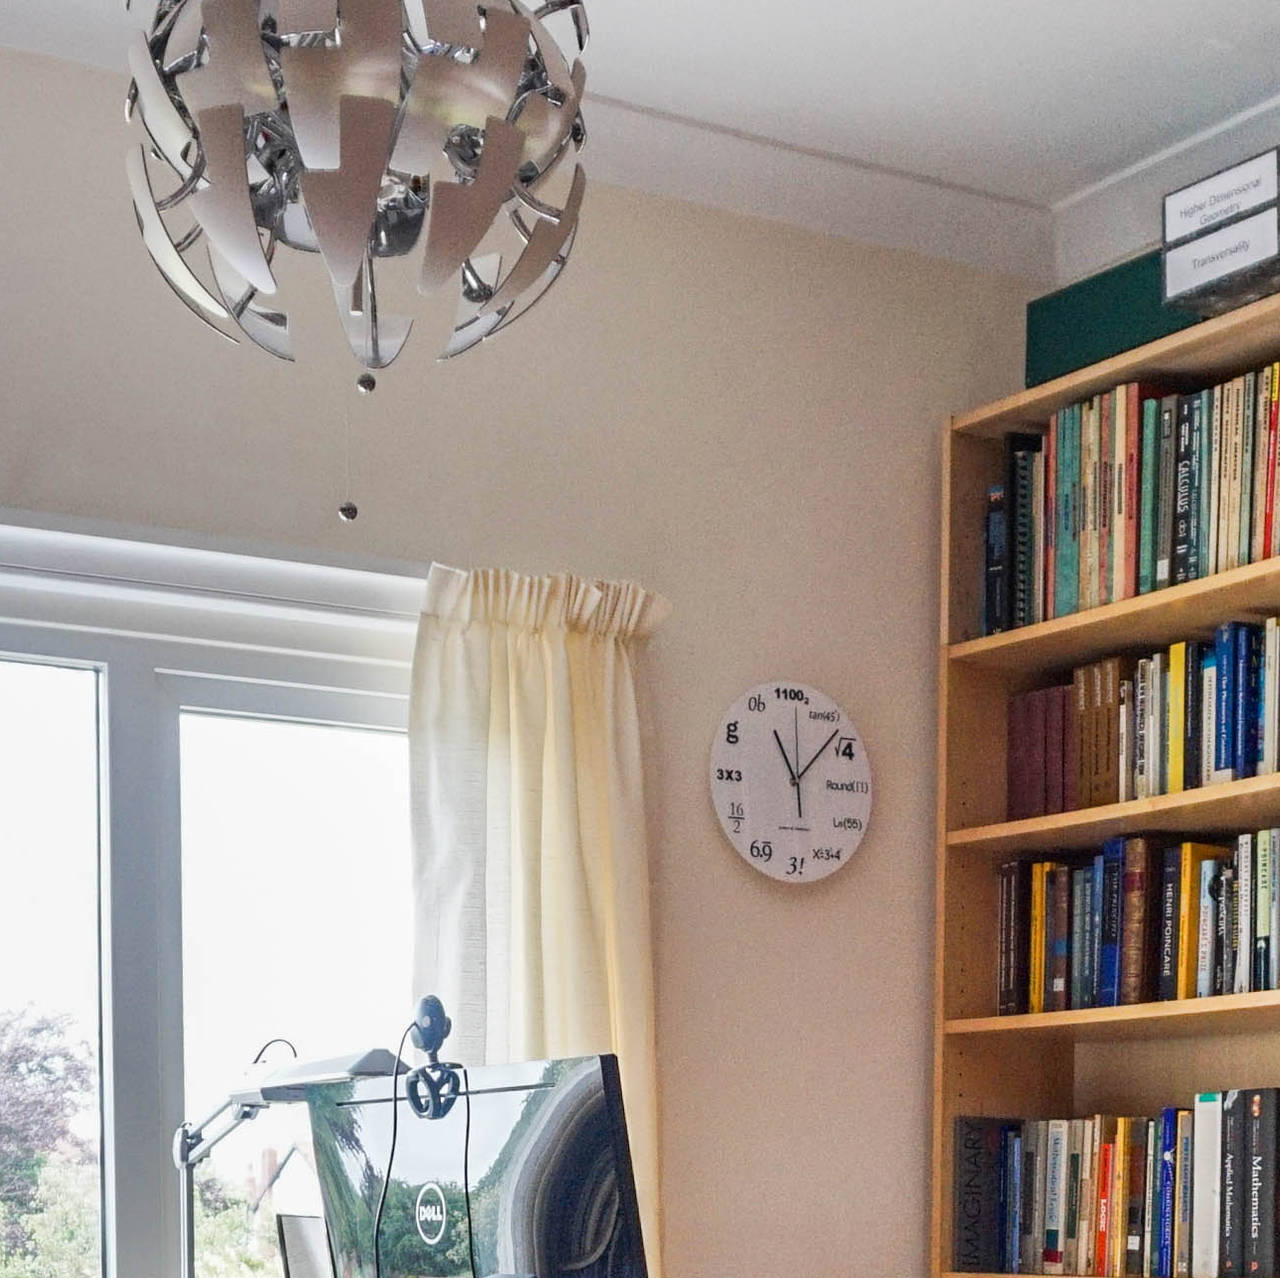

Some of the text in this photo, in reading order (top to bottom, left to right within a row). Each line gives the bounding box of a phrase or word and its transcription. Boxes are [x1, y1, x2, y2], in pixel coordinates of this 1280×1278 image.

[1179, 176, 1262, 219] Higher Dimensional
[1199, 201, 1241, 225] Geometry
[1191, 239, 1251, 270] Transversality
[1178, 460, 1190, 514] CALCULUS
[1220, 676, 1229, 690] The
[1220, 692, 1229, 724] Pleasures
[729, 802, 744, 816] 16
[733, 822, 741, 834] 2
[786, 856, 805, 876] 3!
[1163, 883, 1175, 918] HENRI
[1049, 1136, 1062, 1196] Mathematical
[962, 1120, 983, 1266] IMAGINARY
[1224, 1152, 1234, 1238] Applied Mathematics
[1251, 1155, 1263, 1239] Mathematics
[1099, 1198, 1107, 1232] LOGIC
